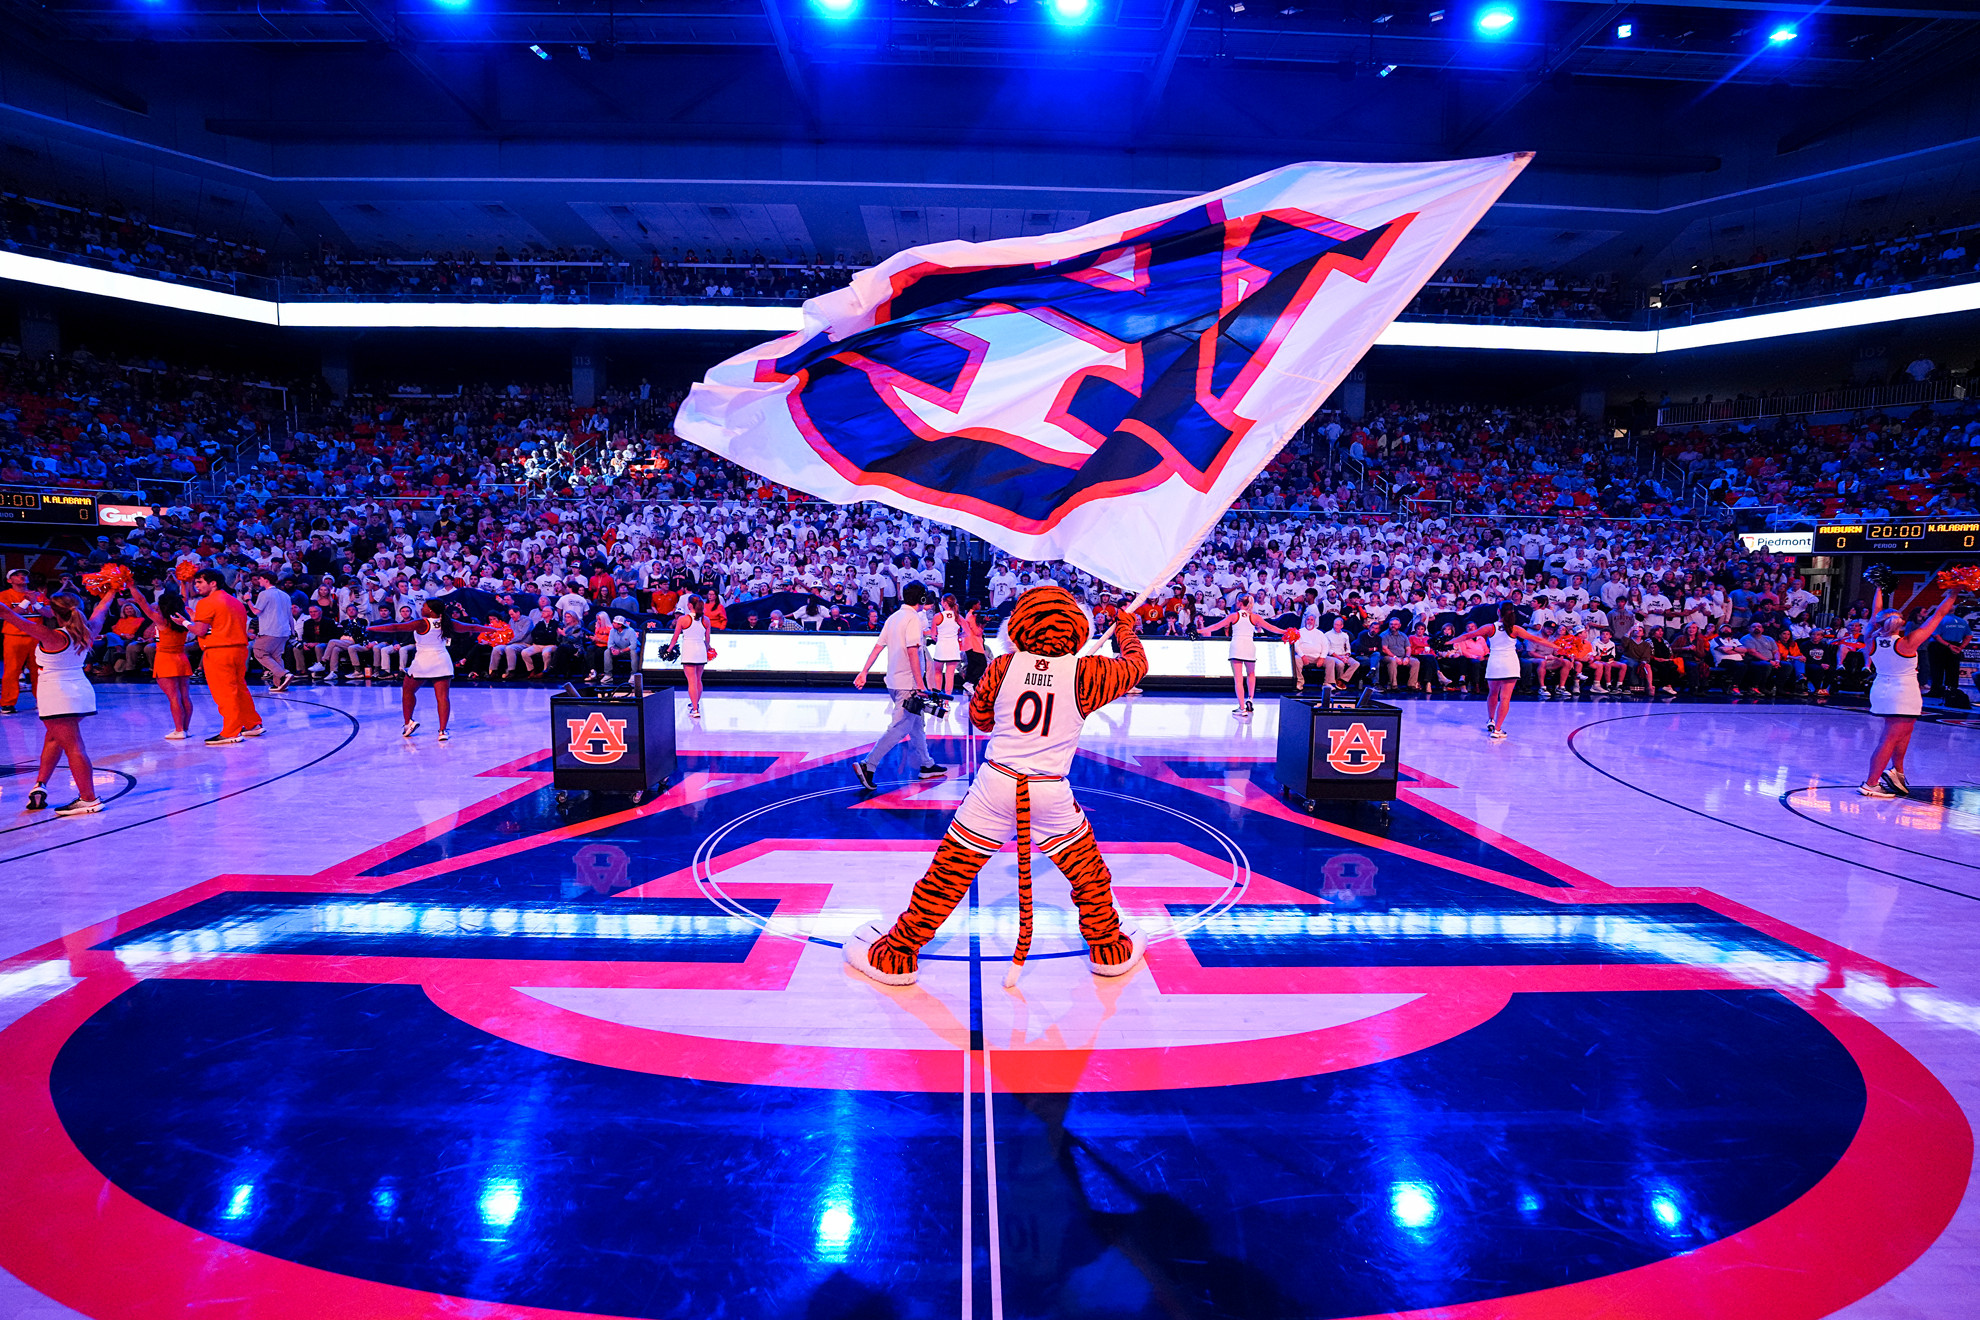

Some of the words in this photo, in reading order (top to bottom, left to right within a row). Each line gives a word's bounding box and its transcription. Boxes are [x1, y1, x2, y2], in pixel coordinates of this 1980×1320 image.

[1858, 346, 1887, 359] 109
[574, 355, 591, 366] 113
[1349, 371, 1364, 382] 110
[42, 495, 92, 506] N.ALABAMA
[79, 508, 89, 520] 0
[1819, 526, 1863, 534] AUBURN
[1871, 525, 1922, 538] 20:00
[1928, 523, 1980, 532] N.ALABAMA
[1757, 537, 1812, 547] Piedmont
[1836, 537, 1847, 549] 0
[1963, 535, 1975, 548] 0
[1034, 659, 1050, 671] AU
[1024, 672, 1053, 687] AUBIE
[1014, 690, 1055, 737] 01
[566, 712, 628, 765] AU
[1326, 723, 1387, 775] AU
